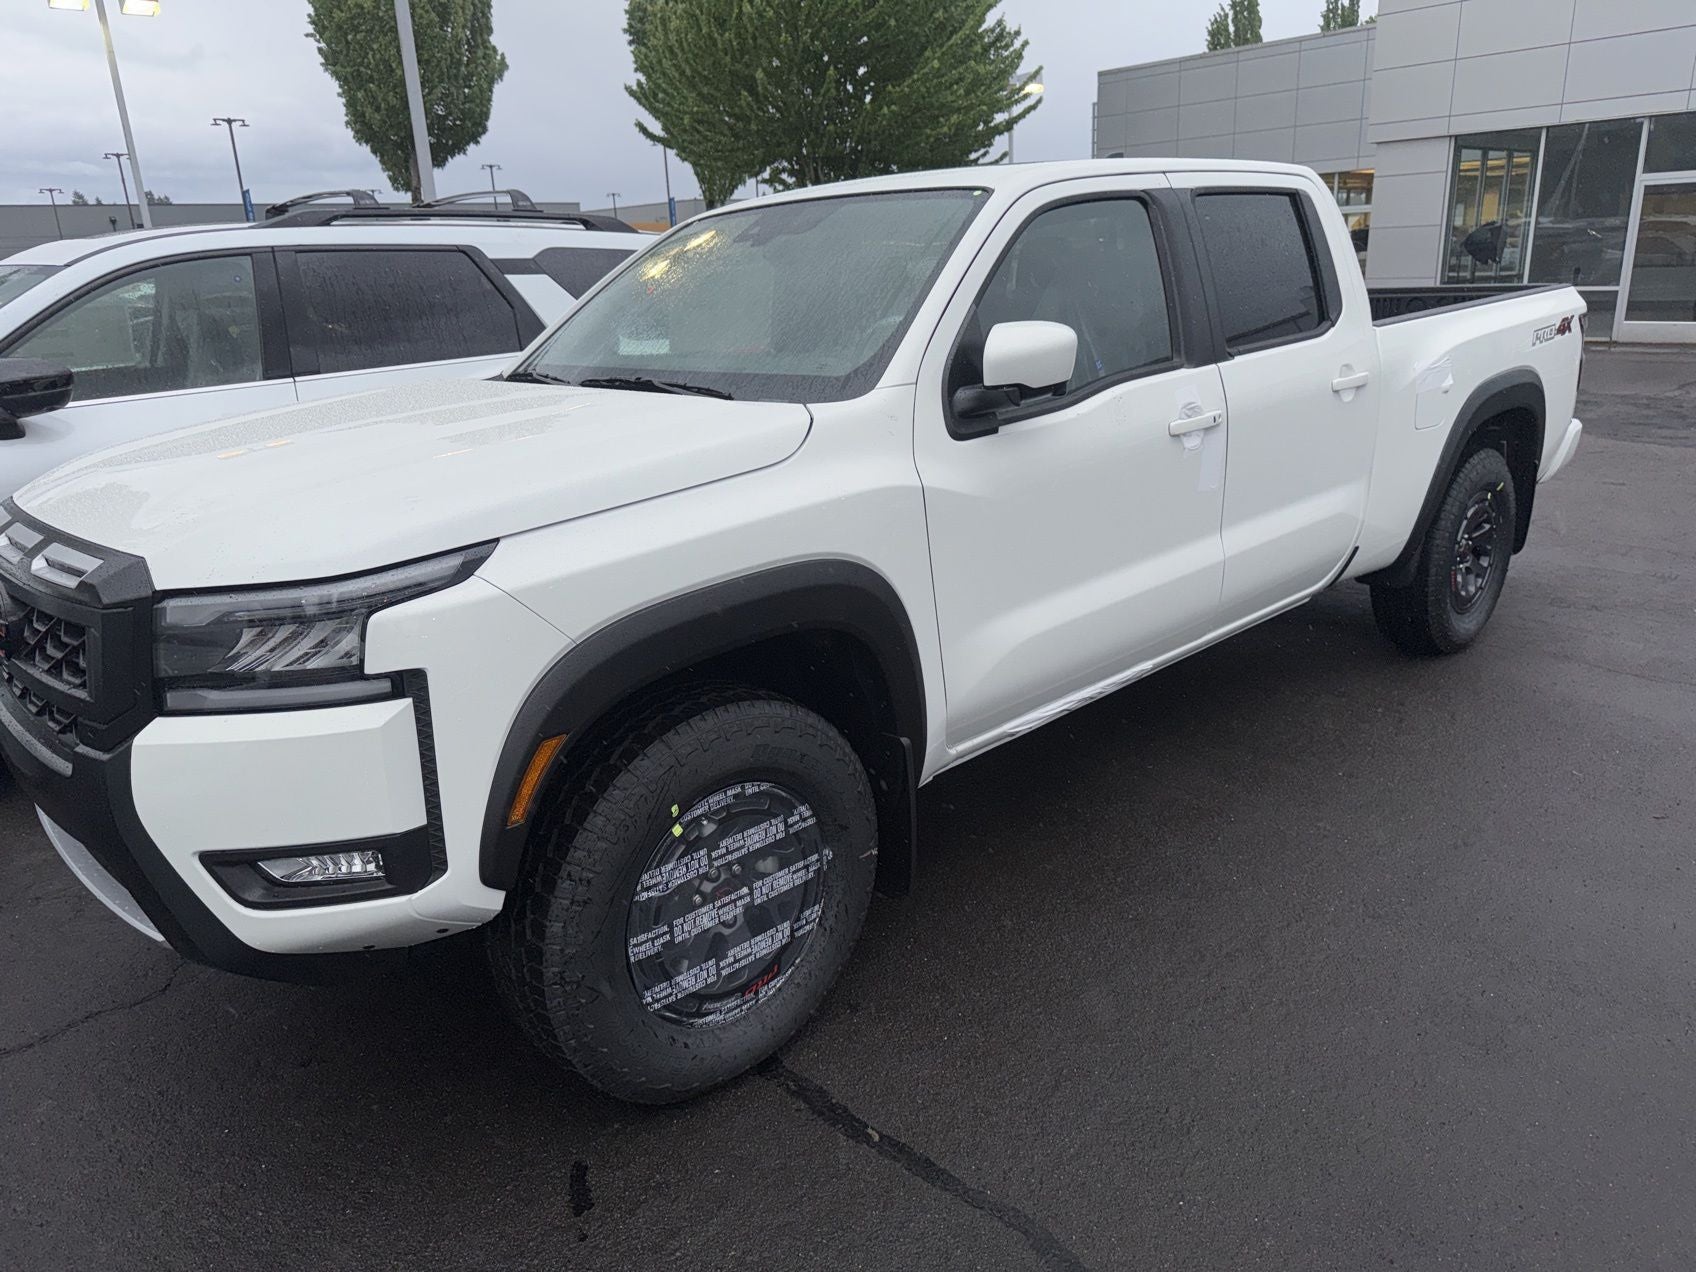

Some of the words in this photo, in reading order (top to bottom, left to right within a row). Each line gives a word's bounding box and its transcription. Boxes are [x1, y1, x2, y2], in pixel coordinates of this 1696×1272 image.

[766, 825, 776, 837] NOT
[778, 821, 784, 832] DO
[744, 830, 765, 846] REMOVE
[776, 830, 784, 840] FOR
[727, 839, 744, 852] WHEEL
[748, 835, 774, 852] CUSTOMER
[710, 846, 726, 859] MASK
[688, 858, 698, 872] NOT
[753, 879, 762, 890] FOR
[763, 867, 788, 885] CUSTOMER
[753, 888, 759, 899] DO
[762, 882, 771, 894] NOT
[673, 916, 683, 927] FOR
[685, 902, 712, 922] CUSTOMER
[674, 924, 681, 937] DO
[683, 919, 694, 932] NOT
[695, 908, 717, 927] REMOVE
[718, 902, 734, 915] WHEEL
[736, 895, 750, 907] MASK
[674, 930, 689, 944] UNTIL
[690, 916, 718, 936] CUSTOMER
[750, 927, 775, 945] CUSTOMER
[783, 926, 790, 938] DO
[773, 931, 781, 943] NOT
[751, 936, 771, 954] REMOVE
[735, 947, 750, 959] WHEEL
[719, 956, 733, 968] MASK
[696, 969, 706, 983] NOT
[708, 965, 716, 977] DO
[706, 974, 716, 984] FOR
